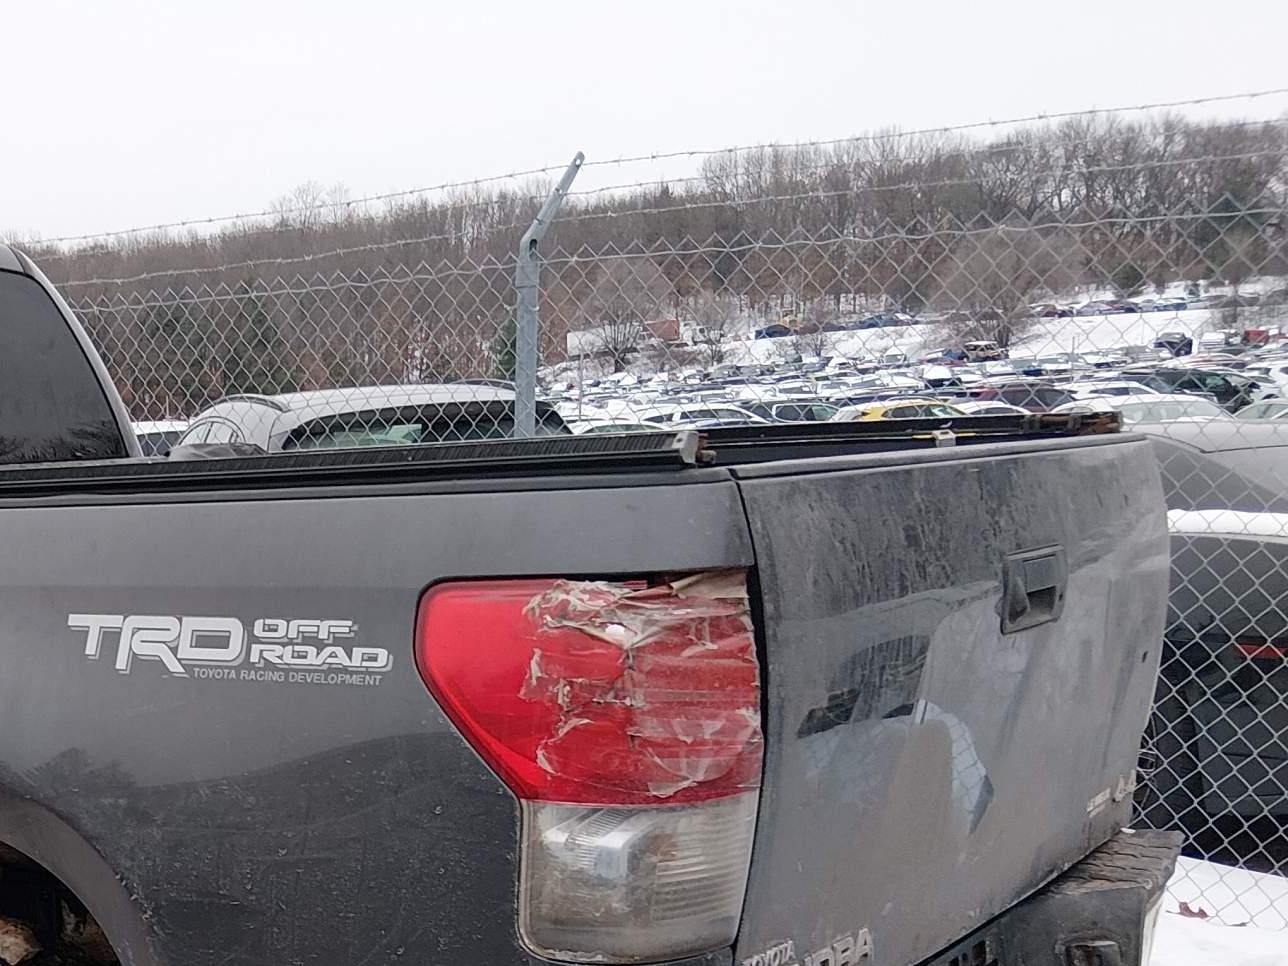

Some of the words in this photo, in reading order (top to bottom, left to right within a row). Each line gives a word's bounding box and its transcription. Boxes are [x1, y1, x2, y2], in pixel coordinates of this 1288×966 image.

[253, 618, 357, 643] OFF
[67, 613, 247, 676] TRD
[249, 643, 393, 672] ROAD
[192, 667, 237, 681] TOYOTA
[239, 669, 285, 683] RACING
[288, 671, 383, 686] DEVELOPMENT
